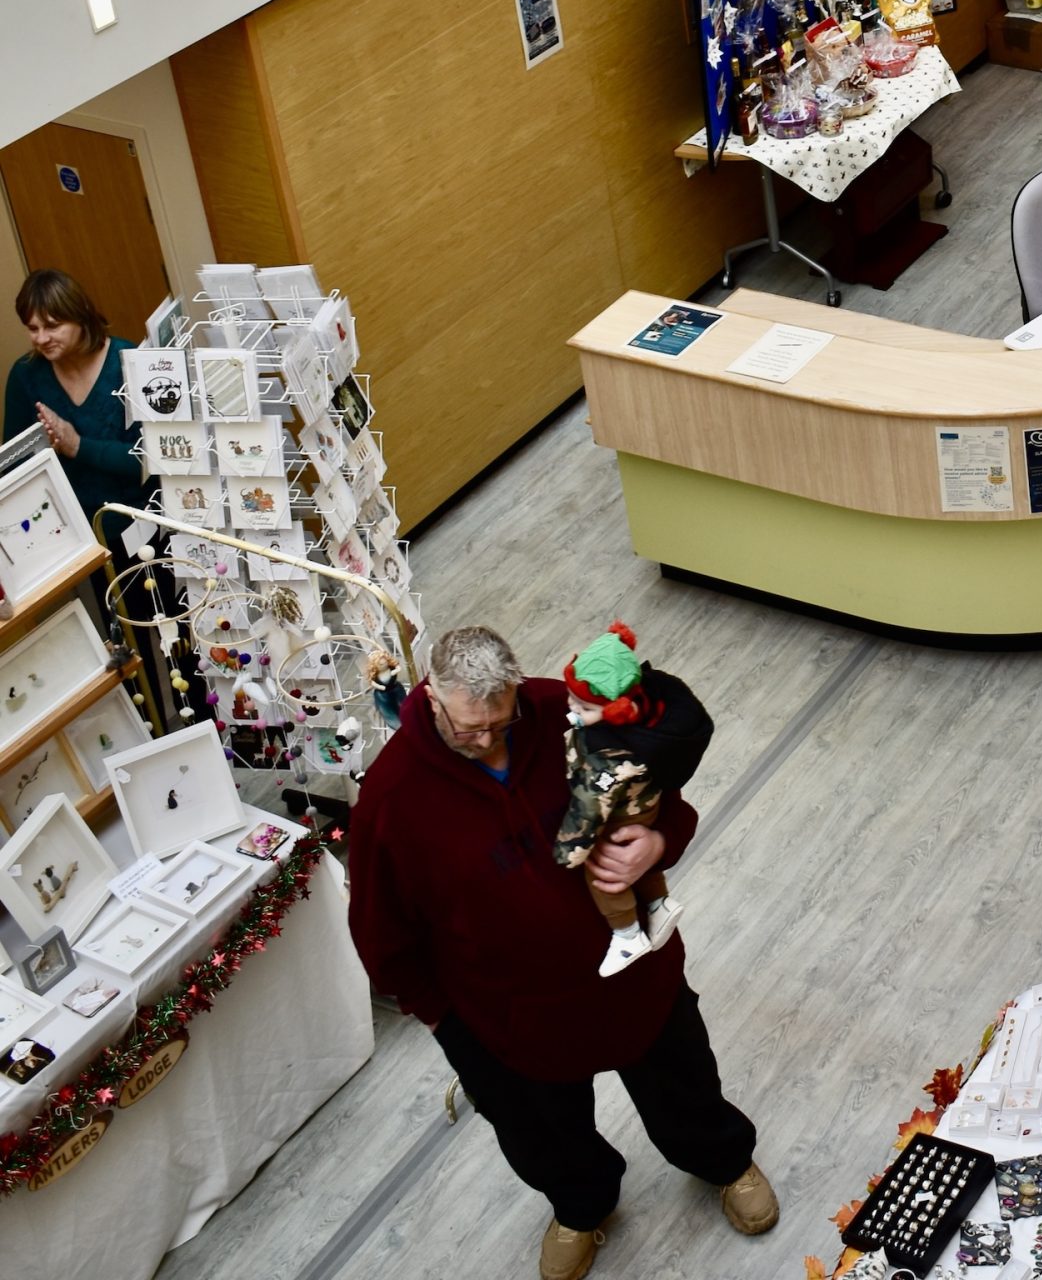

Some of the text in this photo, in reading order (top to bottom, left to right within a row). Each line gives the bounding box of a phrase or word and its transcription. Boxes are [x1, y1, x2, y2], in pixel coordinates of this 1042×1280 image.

[901, 30, 934, 41] CARAMEL
[128, 1053, 173, 1101] LODGE
[34, 1127, 100, 1189] ANTLERS
